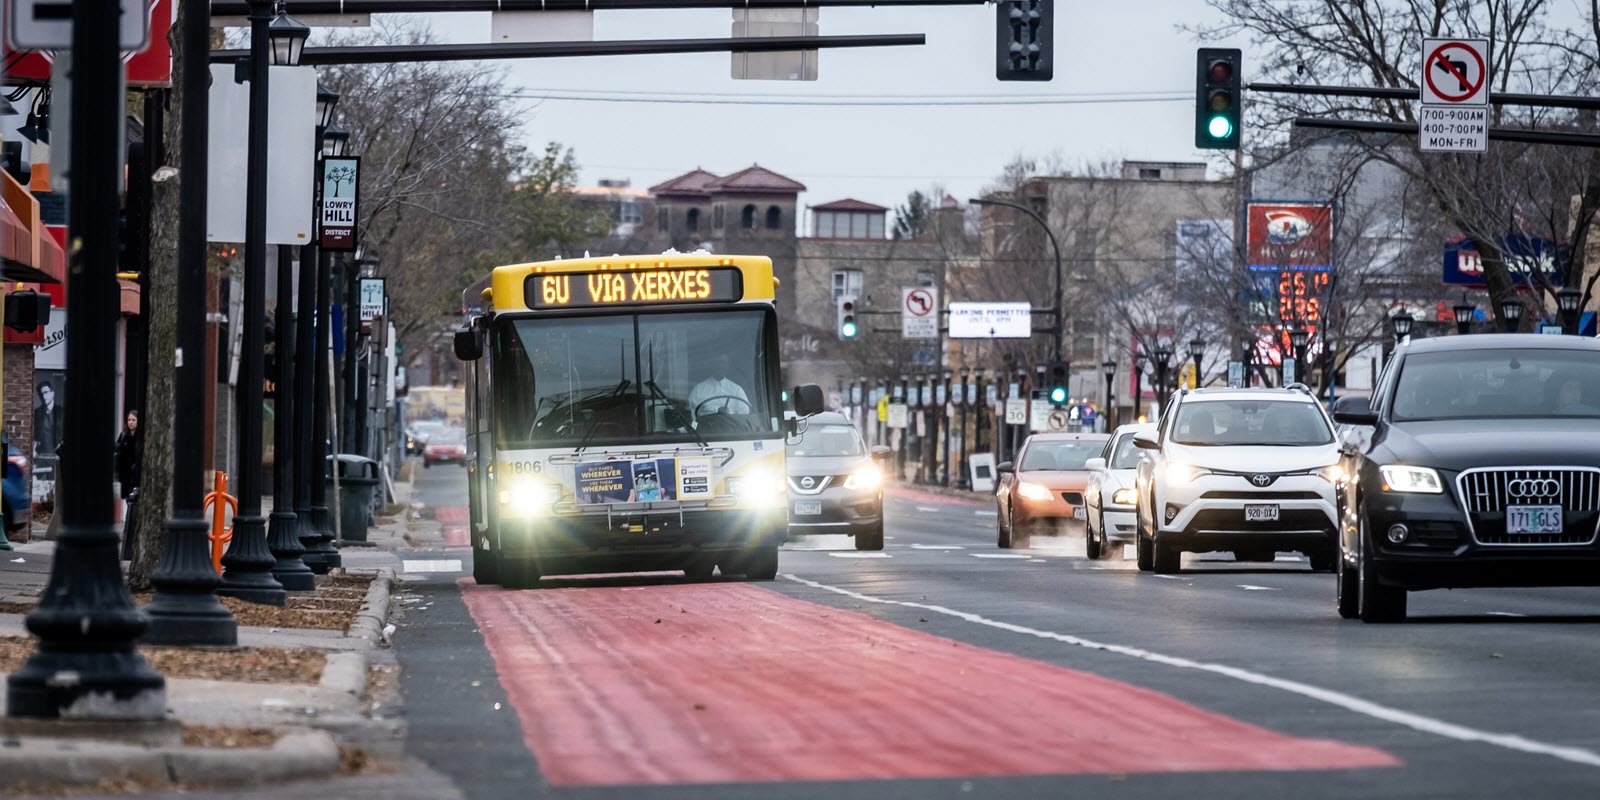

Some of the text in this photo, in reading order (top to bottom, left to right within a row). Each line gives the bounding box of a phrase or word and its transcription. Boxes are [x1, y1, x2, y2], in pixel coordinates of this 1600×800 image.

[1424, 110, 1484, 120] 7:00-9:00AM
[1424, 124, 1484, 134] 4:00-7:00PM
[1430, 138, 1477, 148] MON-FRI
[325, 201, 353, 209] LOWRY
[325, 210, 352, 221] HILL
[542, 270, 711, 304] 6U VIA XERXES
[1009, 412, 1024, 421] 30
[509, 461, 541, 474] 1806
[581, 469, 621, 479] WHEREVER
[582, 483, 623, 493] WHENEVER
[1511, 512, 1561, 527] 171 GLS
